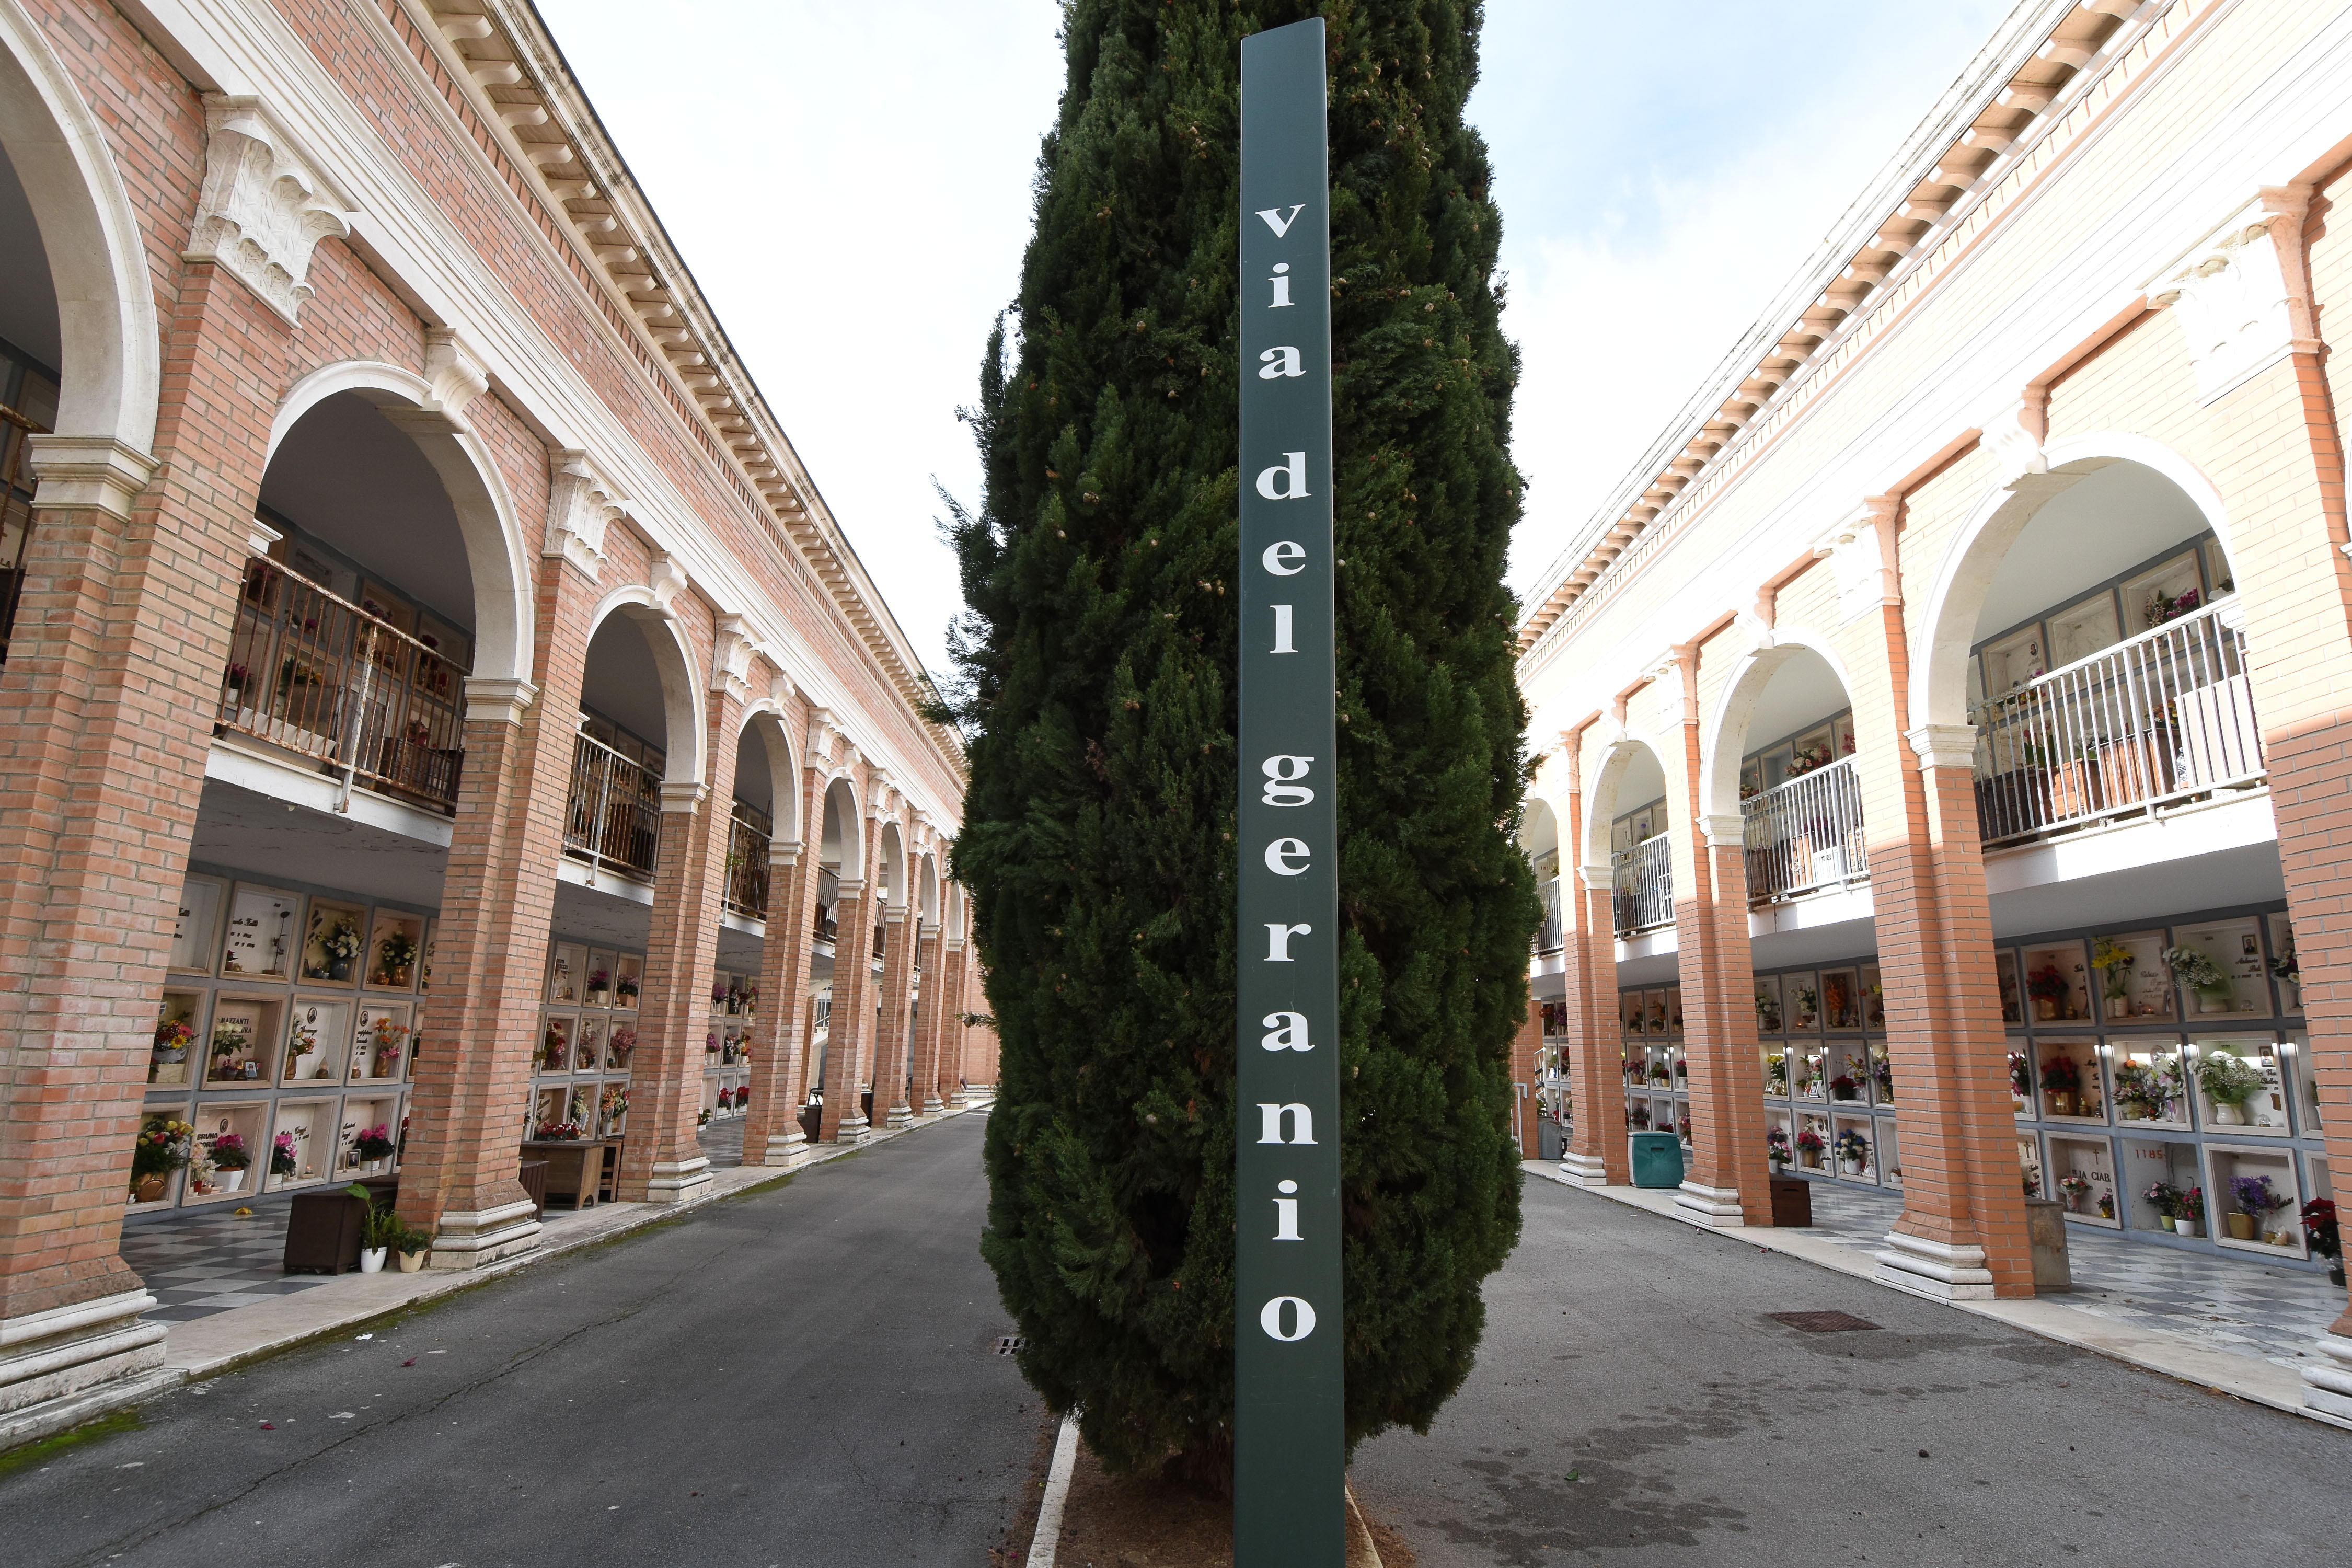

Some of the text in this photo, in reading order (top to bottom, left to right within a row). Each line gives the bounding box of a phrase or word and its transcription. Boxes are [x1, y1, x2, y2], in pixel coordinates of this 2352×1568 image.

[1254, 204, 1318, 1341] via del geranio
[197, 1132, 218, 1140] BRUNA
